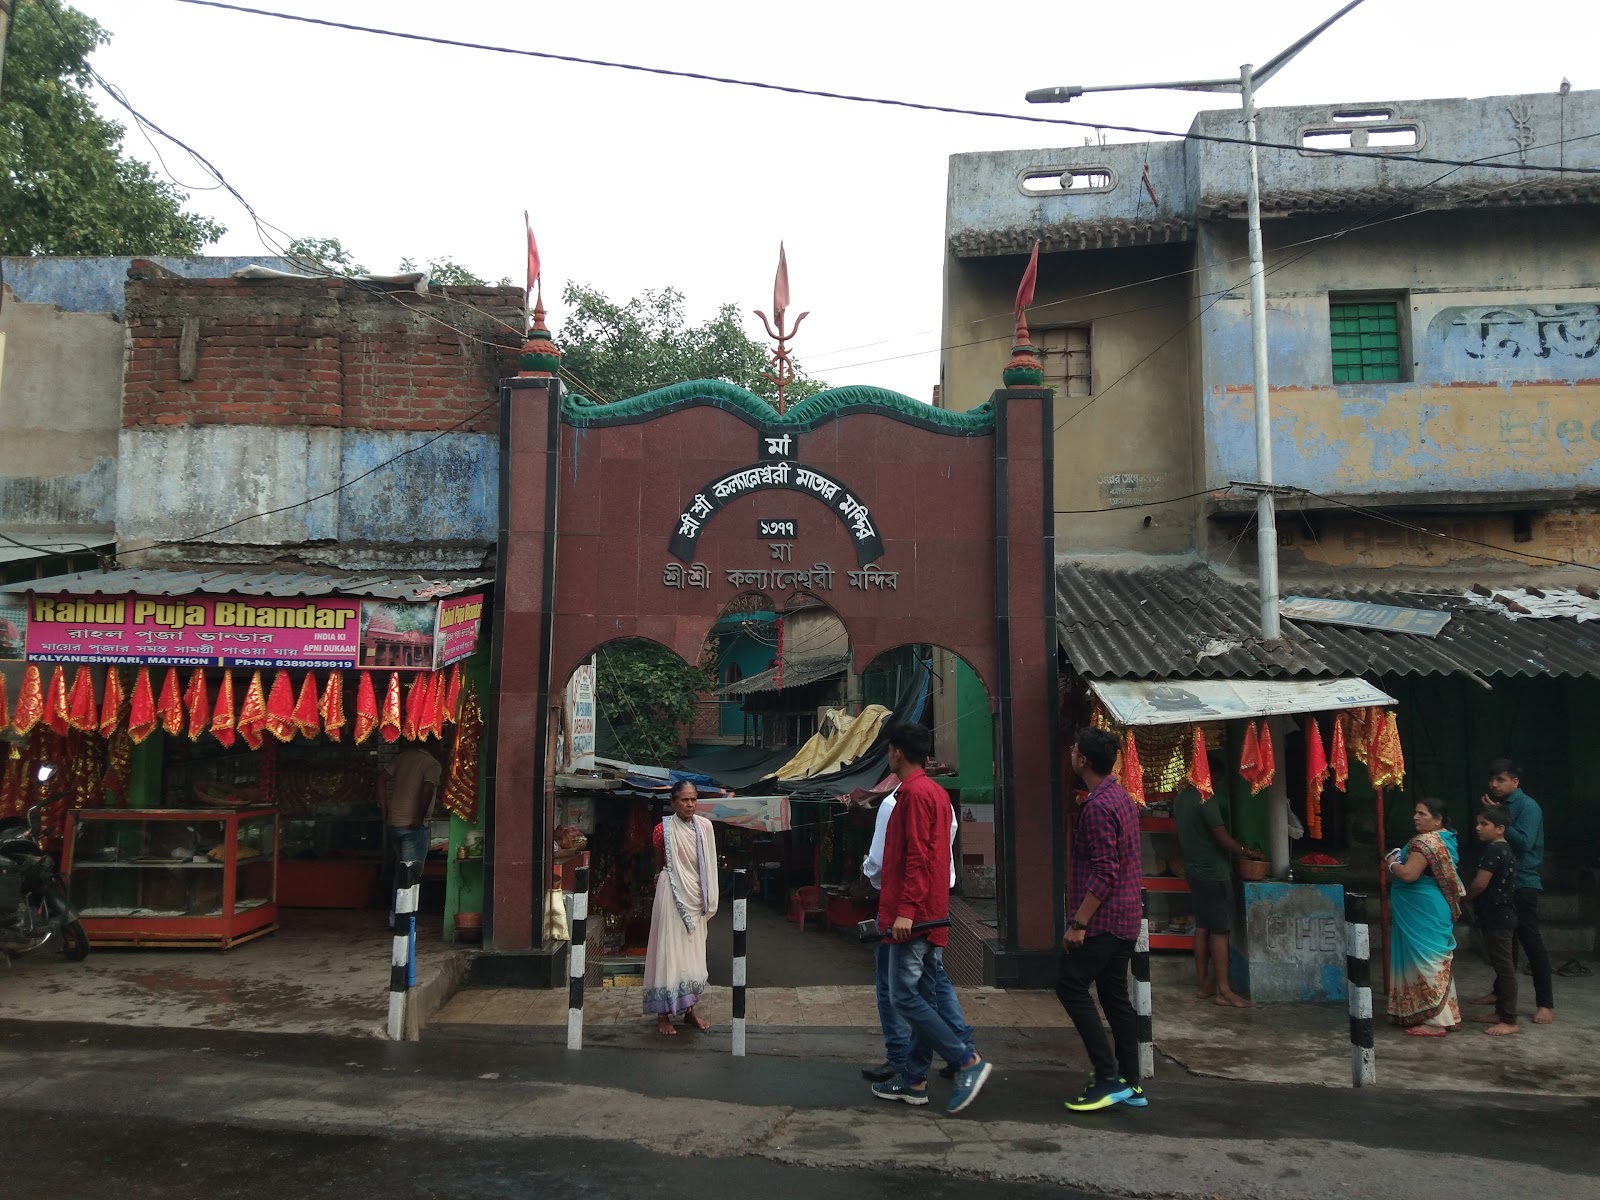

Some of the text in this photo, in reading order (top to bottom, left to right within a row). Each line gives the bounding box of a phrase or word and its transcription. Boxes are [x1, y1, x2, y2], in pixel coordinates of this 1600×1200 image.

[690, 493, 714, 519] শ্রী
[796, 468, 842, 500] মাতার
[838, 494, 876, 540] মন্দির
[761, 521, 794, 536] ১৩৭৭
[768, 542, 793, 562] মা
[846, 562, 899, 590] মন্দির
[34, 599, 356, 629] Rahul Puja Bhandar
[314, 633, 346, 641] INDIA KI
[303, 644, 356, 653] APNI DUKAAN
[29, 654, 209, 665] KALYANESHWARI, MAITHON
[235, 658, 353, 668] Ph-No 8389059919
